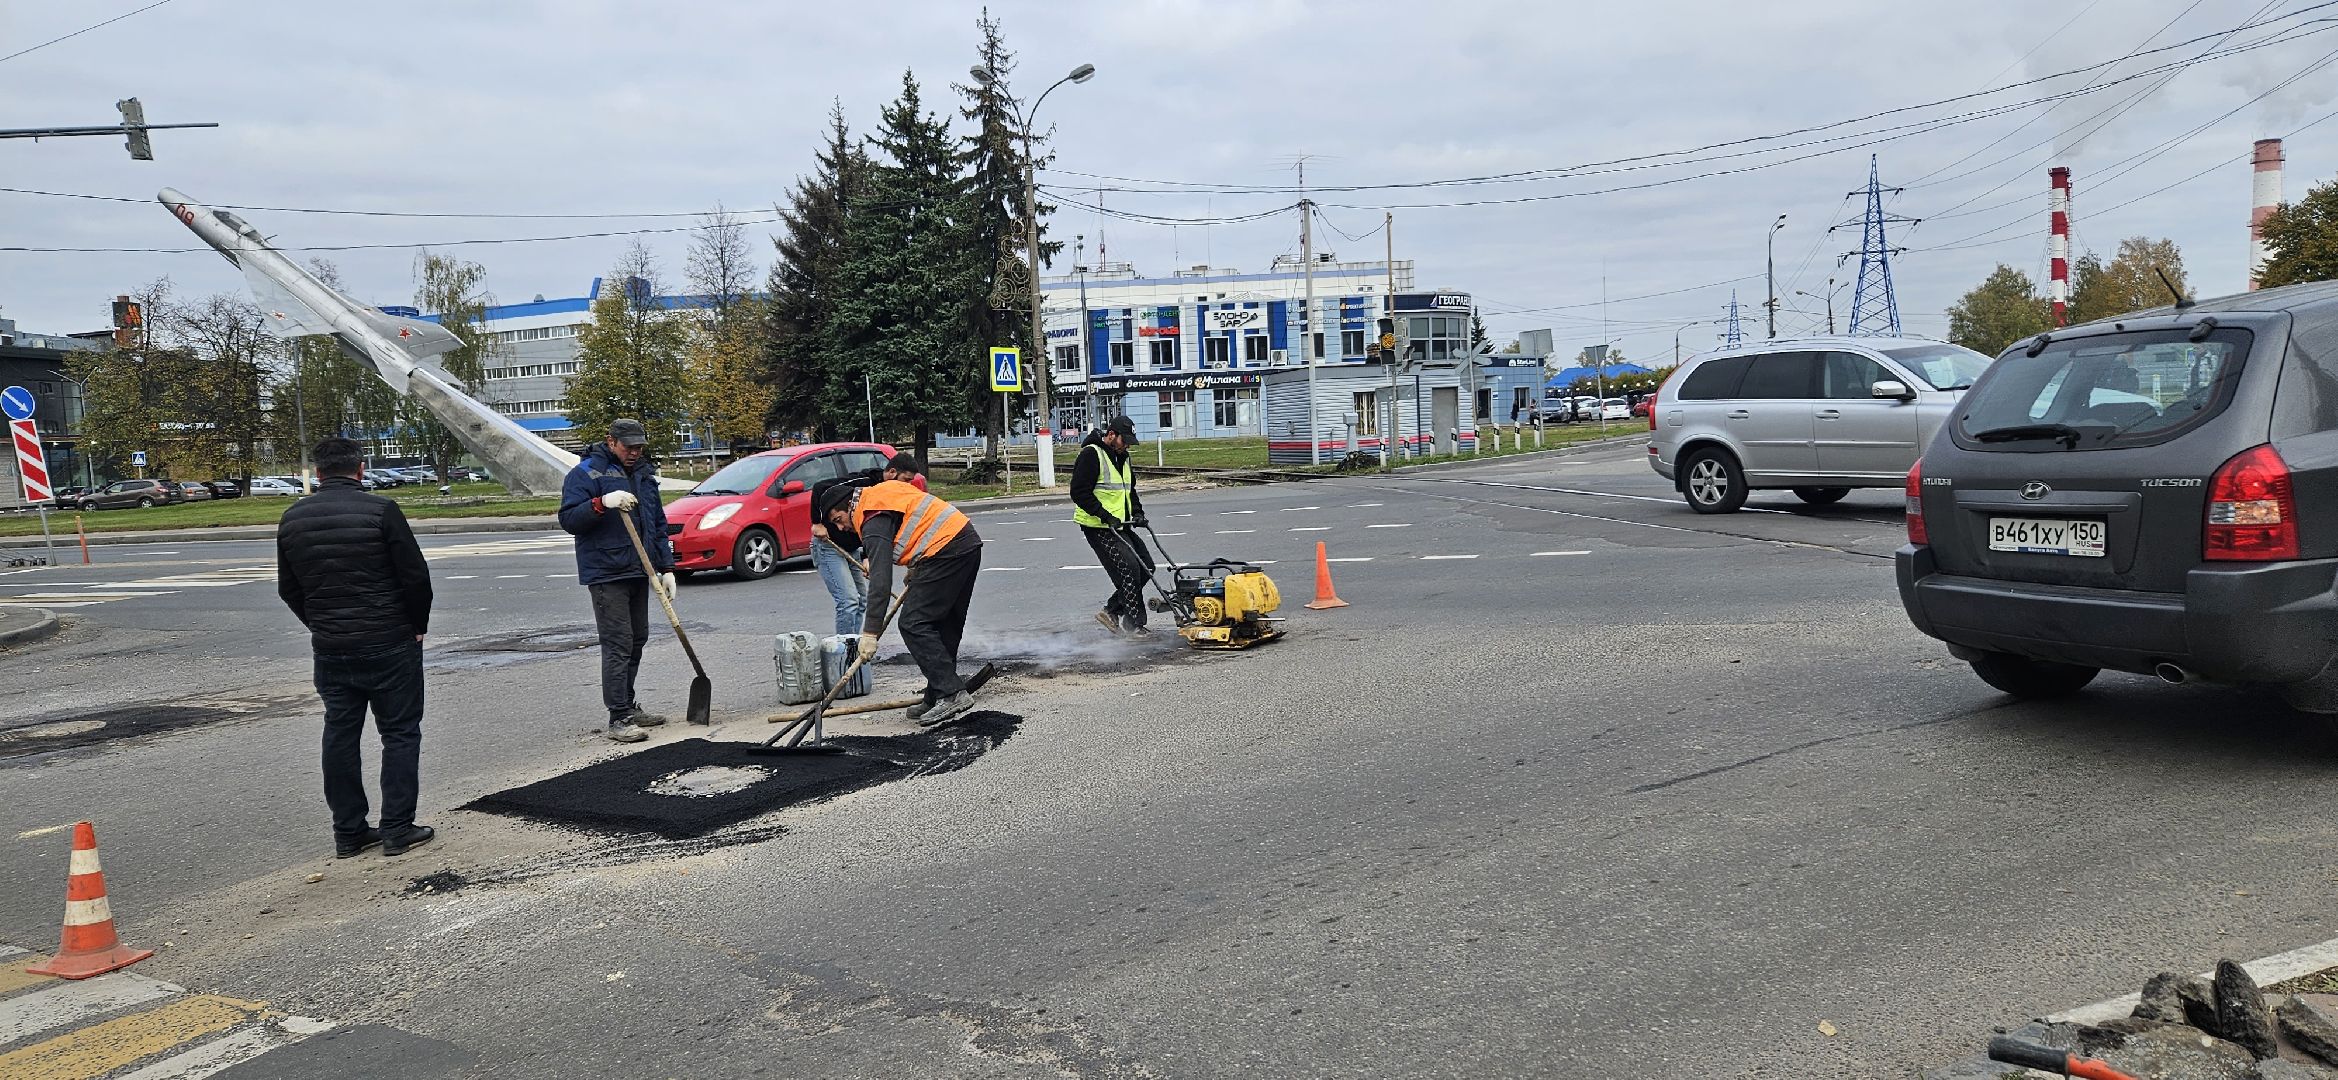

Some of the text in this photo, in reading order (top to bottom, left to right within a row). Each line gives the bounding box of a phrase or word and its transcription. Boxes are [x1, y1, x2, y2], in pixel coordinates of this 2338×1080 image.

[1126, 375, 1261, 388] детский клуб Милана Kids
[2140, 478, 2202, 487] TUCSON
[2069, 522, 2099, 541] 150
[2076, 540, 2091, 548] RUS
